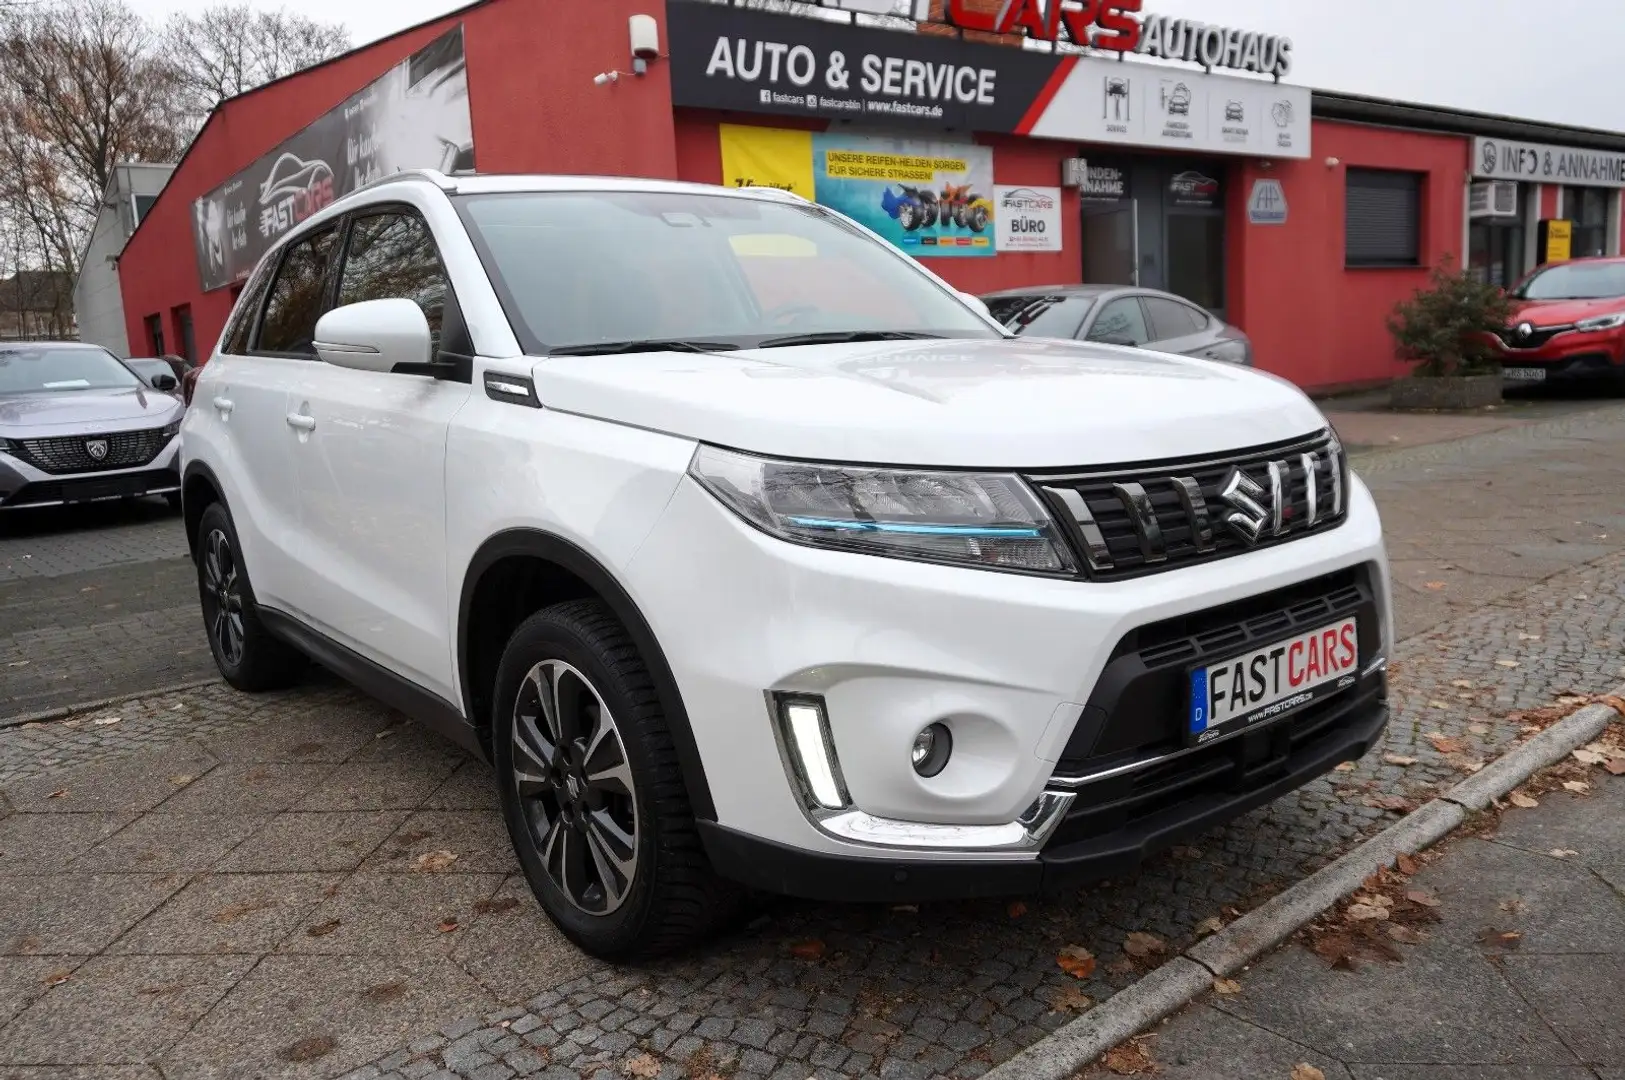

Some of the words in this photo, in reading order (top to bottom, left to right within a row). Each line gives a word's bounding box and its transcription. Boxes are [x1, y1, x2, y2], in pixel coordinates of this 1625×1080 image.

[1140, 13, 1293, 76] AUTOHAUS
[706, 36, 816, 86] AUTO
[825, 50, 850, 89] &
[860, 53, 997, 103] SERVICE
[773, 92, 804, 104] fastcars
[868, 100, 943, 116] www.fastcars.de
[828, 152, 864, 163] UNSERE
[865, 154, 932, 169] REIFEN-HELDEN
[933, 159, 966, 170] SORGEN
[848, 167, 885, 177] SICHERE
[887, 168, 933, 180] STRASSEN!
[1011, 215, 1045, 233] BÜRO
[1195, 707, 1203, 722] D
